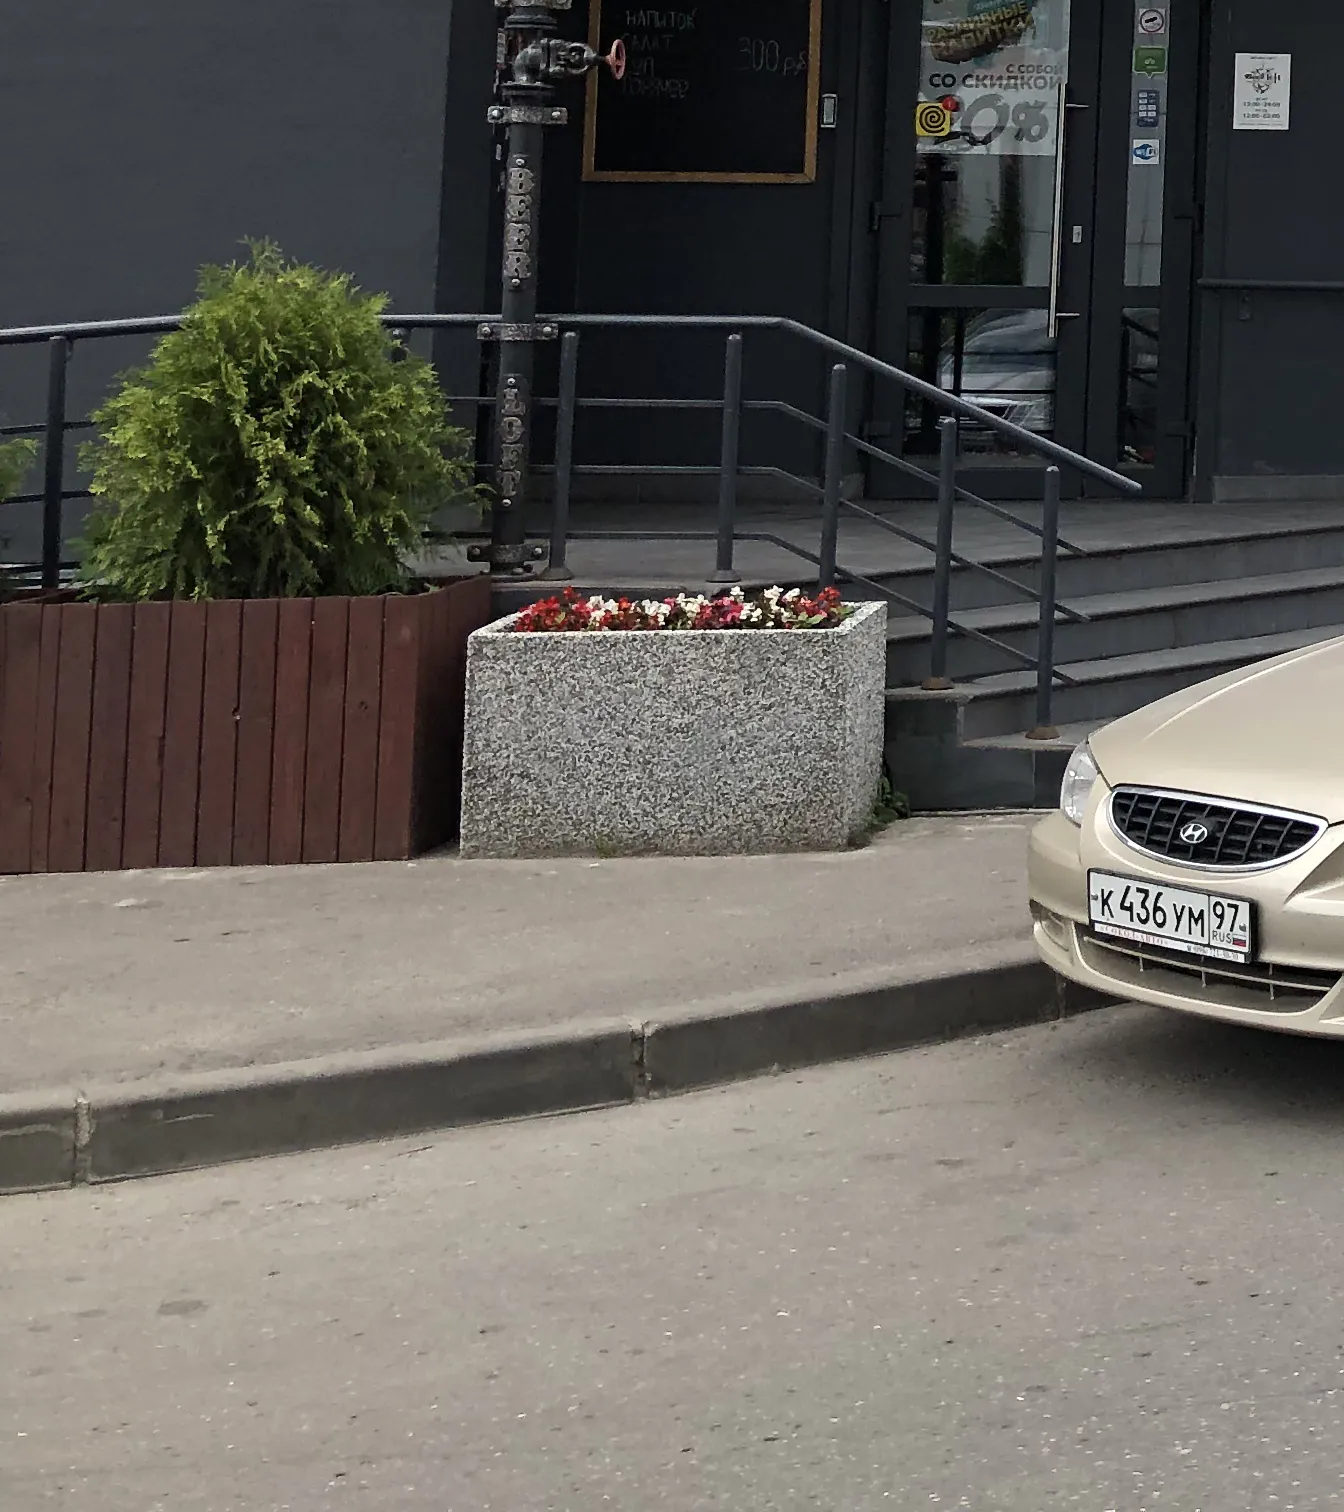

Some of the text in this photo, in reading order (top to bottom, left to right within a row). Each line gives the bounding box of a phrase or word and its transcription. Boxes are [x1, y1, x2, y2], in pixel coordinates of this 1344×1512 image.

[929, 73, 957, 89] СО
[1212, 900, 1239, 933] 97
[1212, 930, 1232, 944] RUS
